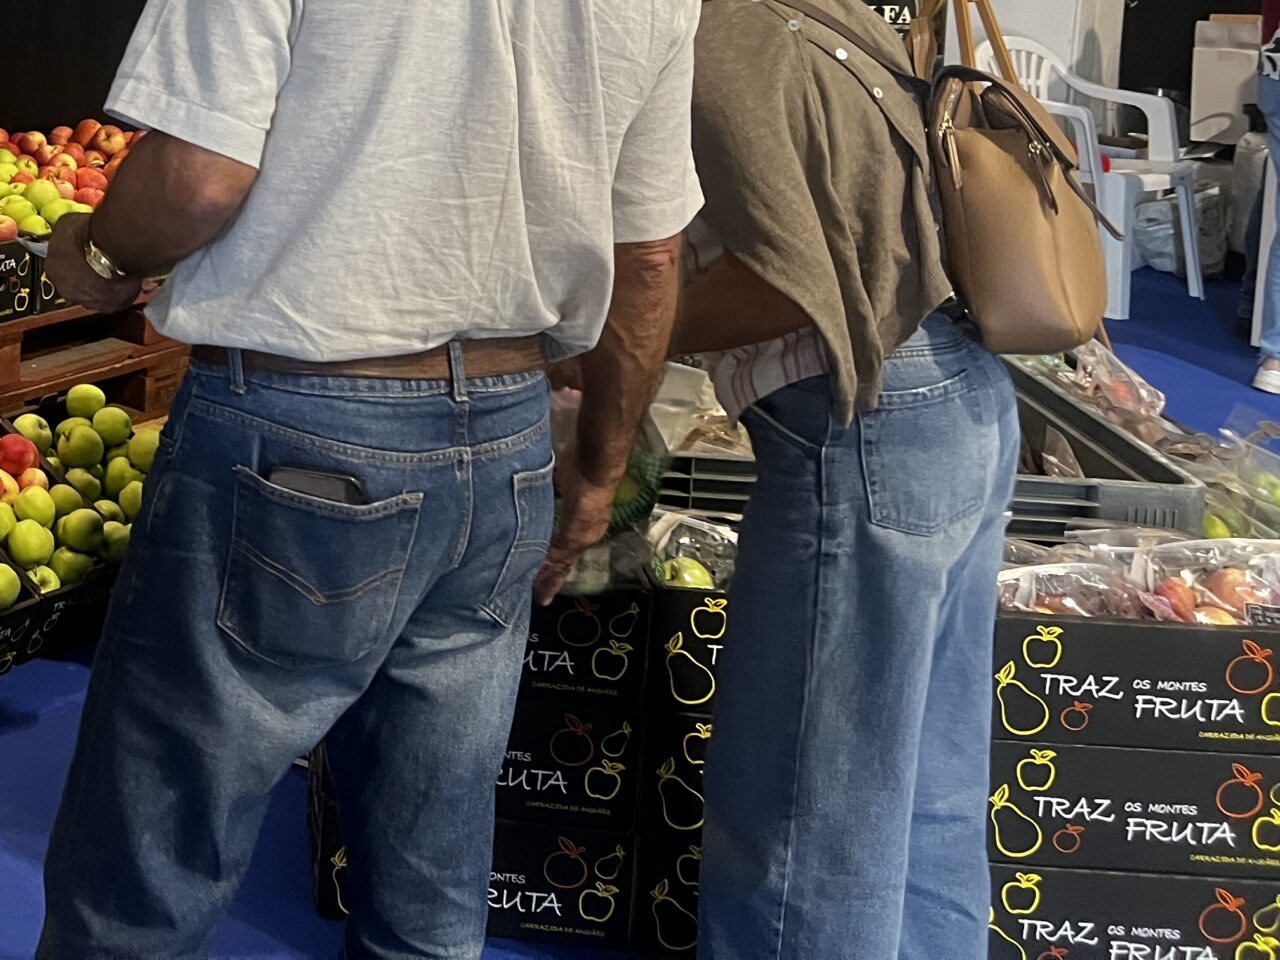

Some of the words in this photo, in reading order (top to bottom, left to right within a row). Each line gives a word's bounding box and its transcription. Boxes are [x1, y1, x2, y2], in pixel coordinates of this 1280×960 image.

[869, 5, 912, 24] FA
[1041, 673, 1124, 700] TRAZ
[1132, 679, 1151, 691] OS
[1157, 679, 1207, 692] MONTES
[1134, 695, 1246, 724] FRUTA
[1033, 796, 1116, 822] TRAZ
[1124, 801, 1143, 813] OS
[1148, 802, 1198, 815] MONTES
[1126, 818, 1236, 848] FRUTA
[489, 871, 526, 884] ONTES
[487, 888, 562, 916] RUTA
[1018, 918, 1099, 945] TRAZ
[1107, 924, 1125, 936] OS
[1130, 925, 1182, 940] MONTES
